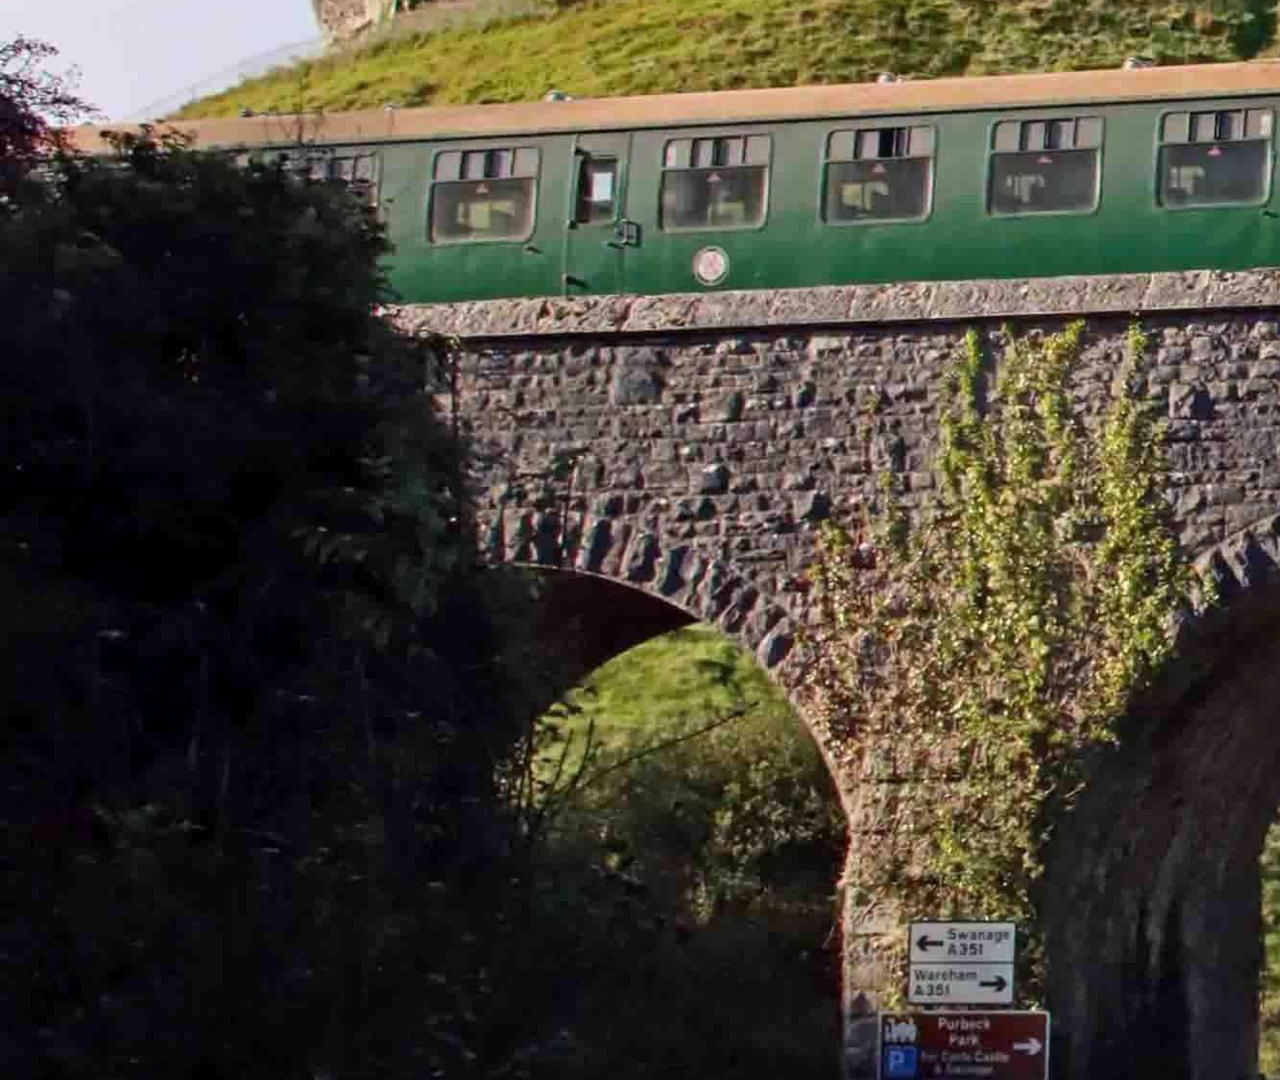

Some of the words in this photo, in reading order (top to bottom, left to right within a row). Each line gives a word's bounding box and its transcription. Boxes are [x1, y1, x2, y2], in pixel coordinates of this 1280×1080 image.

[947, 928, 1010, 943] Swanage
[947, 943, 983, 956] A351
[914, 969, 978, 981] Wareham
[914, 983, 950, 996] A351
[938, 1017, 991, 1031] Purbeck
[950, 1034, 981, 1046] Park
[888, 1050, 905, 1072] P
